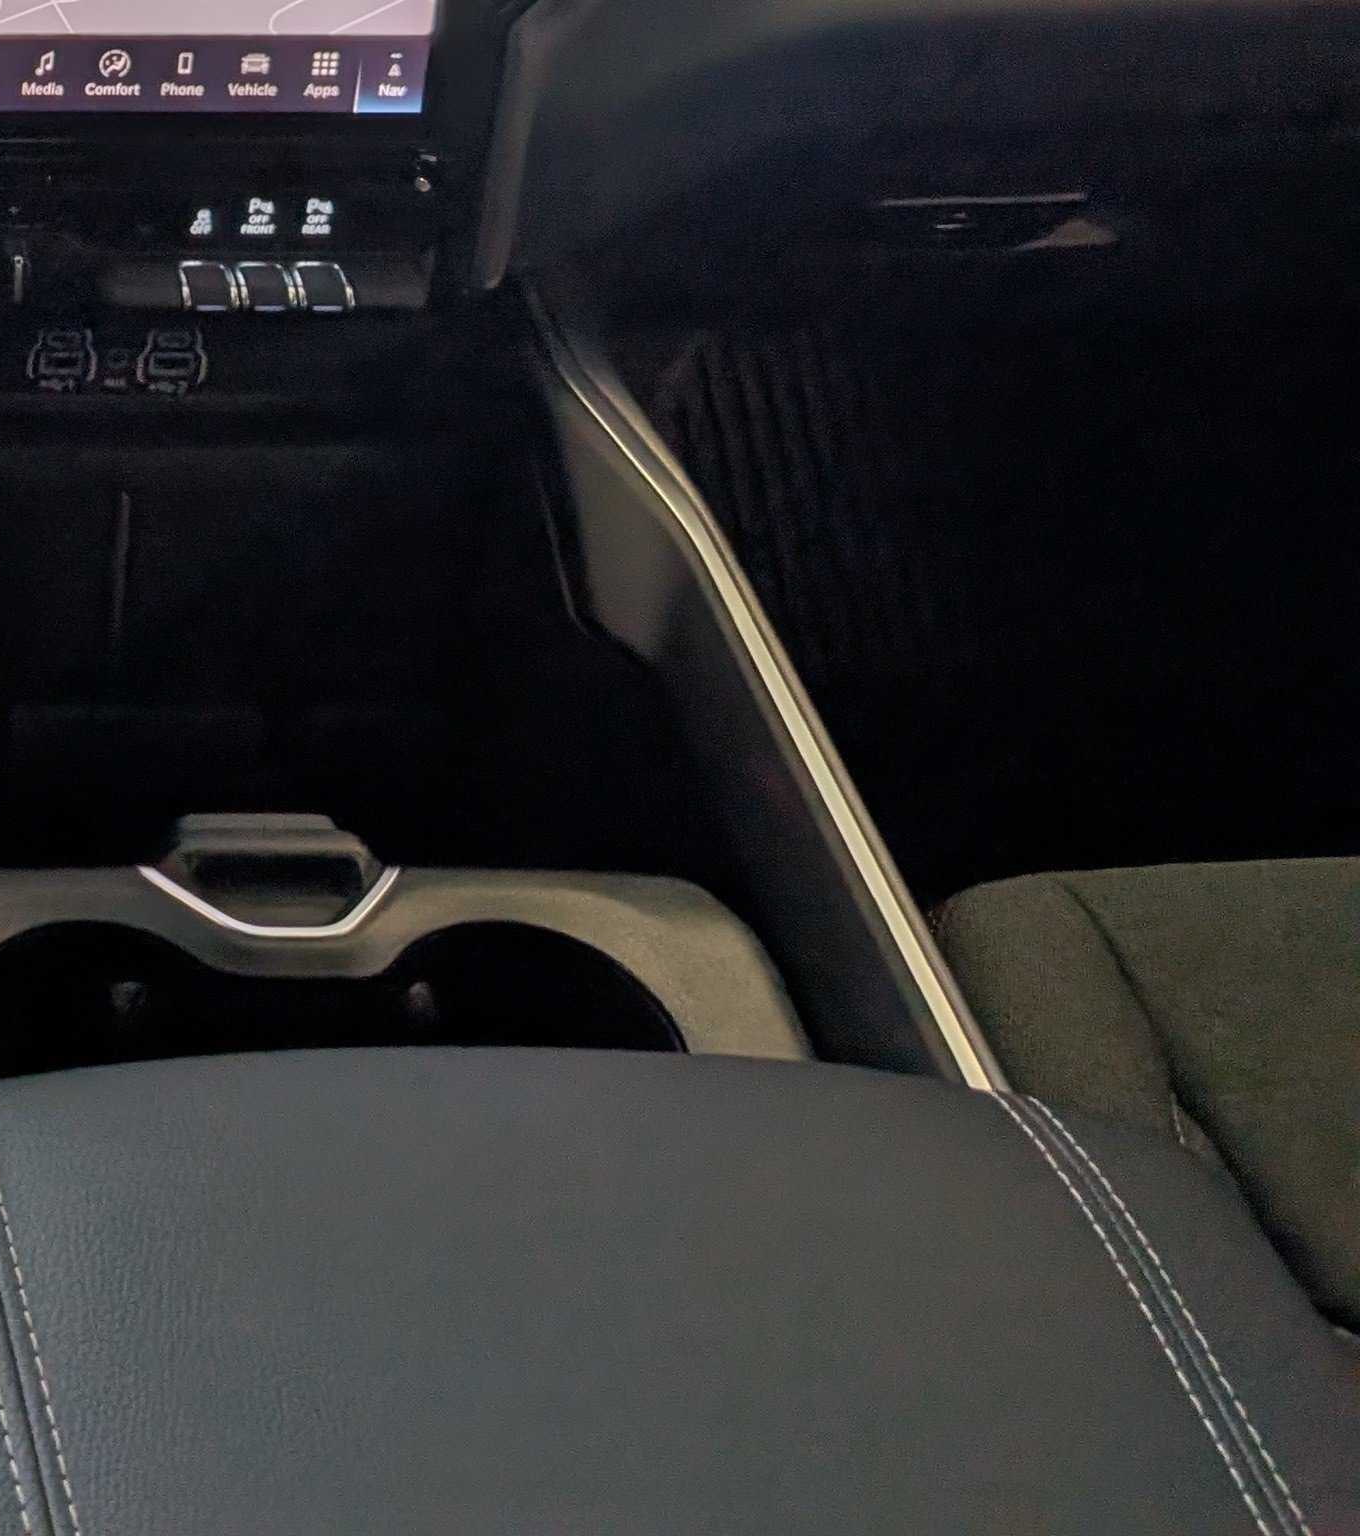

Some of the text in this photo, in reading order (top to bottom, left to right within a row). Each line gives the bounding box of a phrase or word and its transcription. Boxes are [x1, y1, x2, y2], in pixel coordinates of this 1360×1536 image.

[20, 81, 65, 97] Media
[84, 81, 141, 97] Comfort
[159, 82, 205, 97] Phone
[227, 82, 278, 97] Vehicle
[302, 82, 341, 99] Apps
[377, 83, 407, 97] Nav
[248, 213, 271, 224] OFF
[306, 213, 330, 224] OFF
[240, 224, 276, 235] FRONT
[301, 224, 331, 235] REAR
